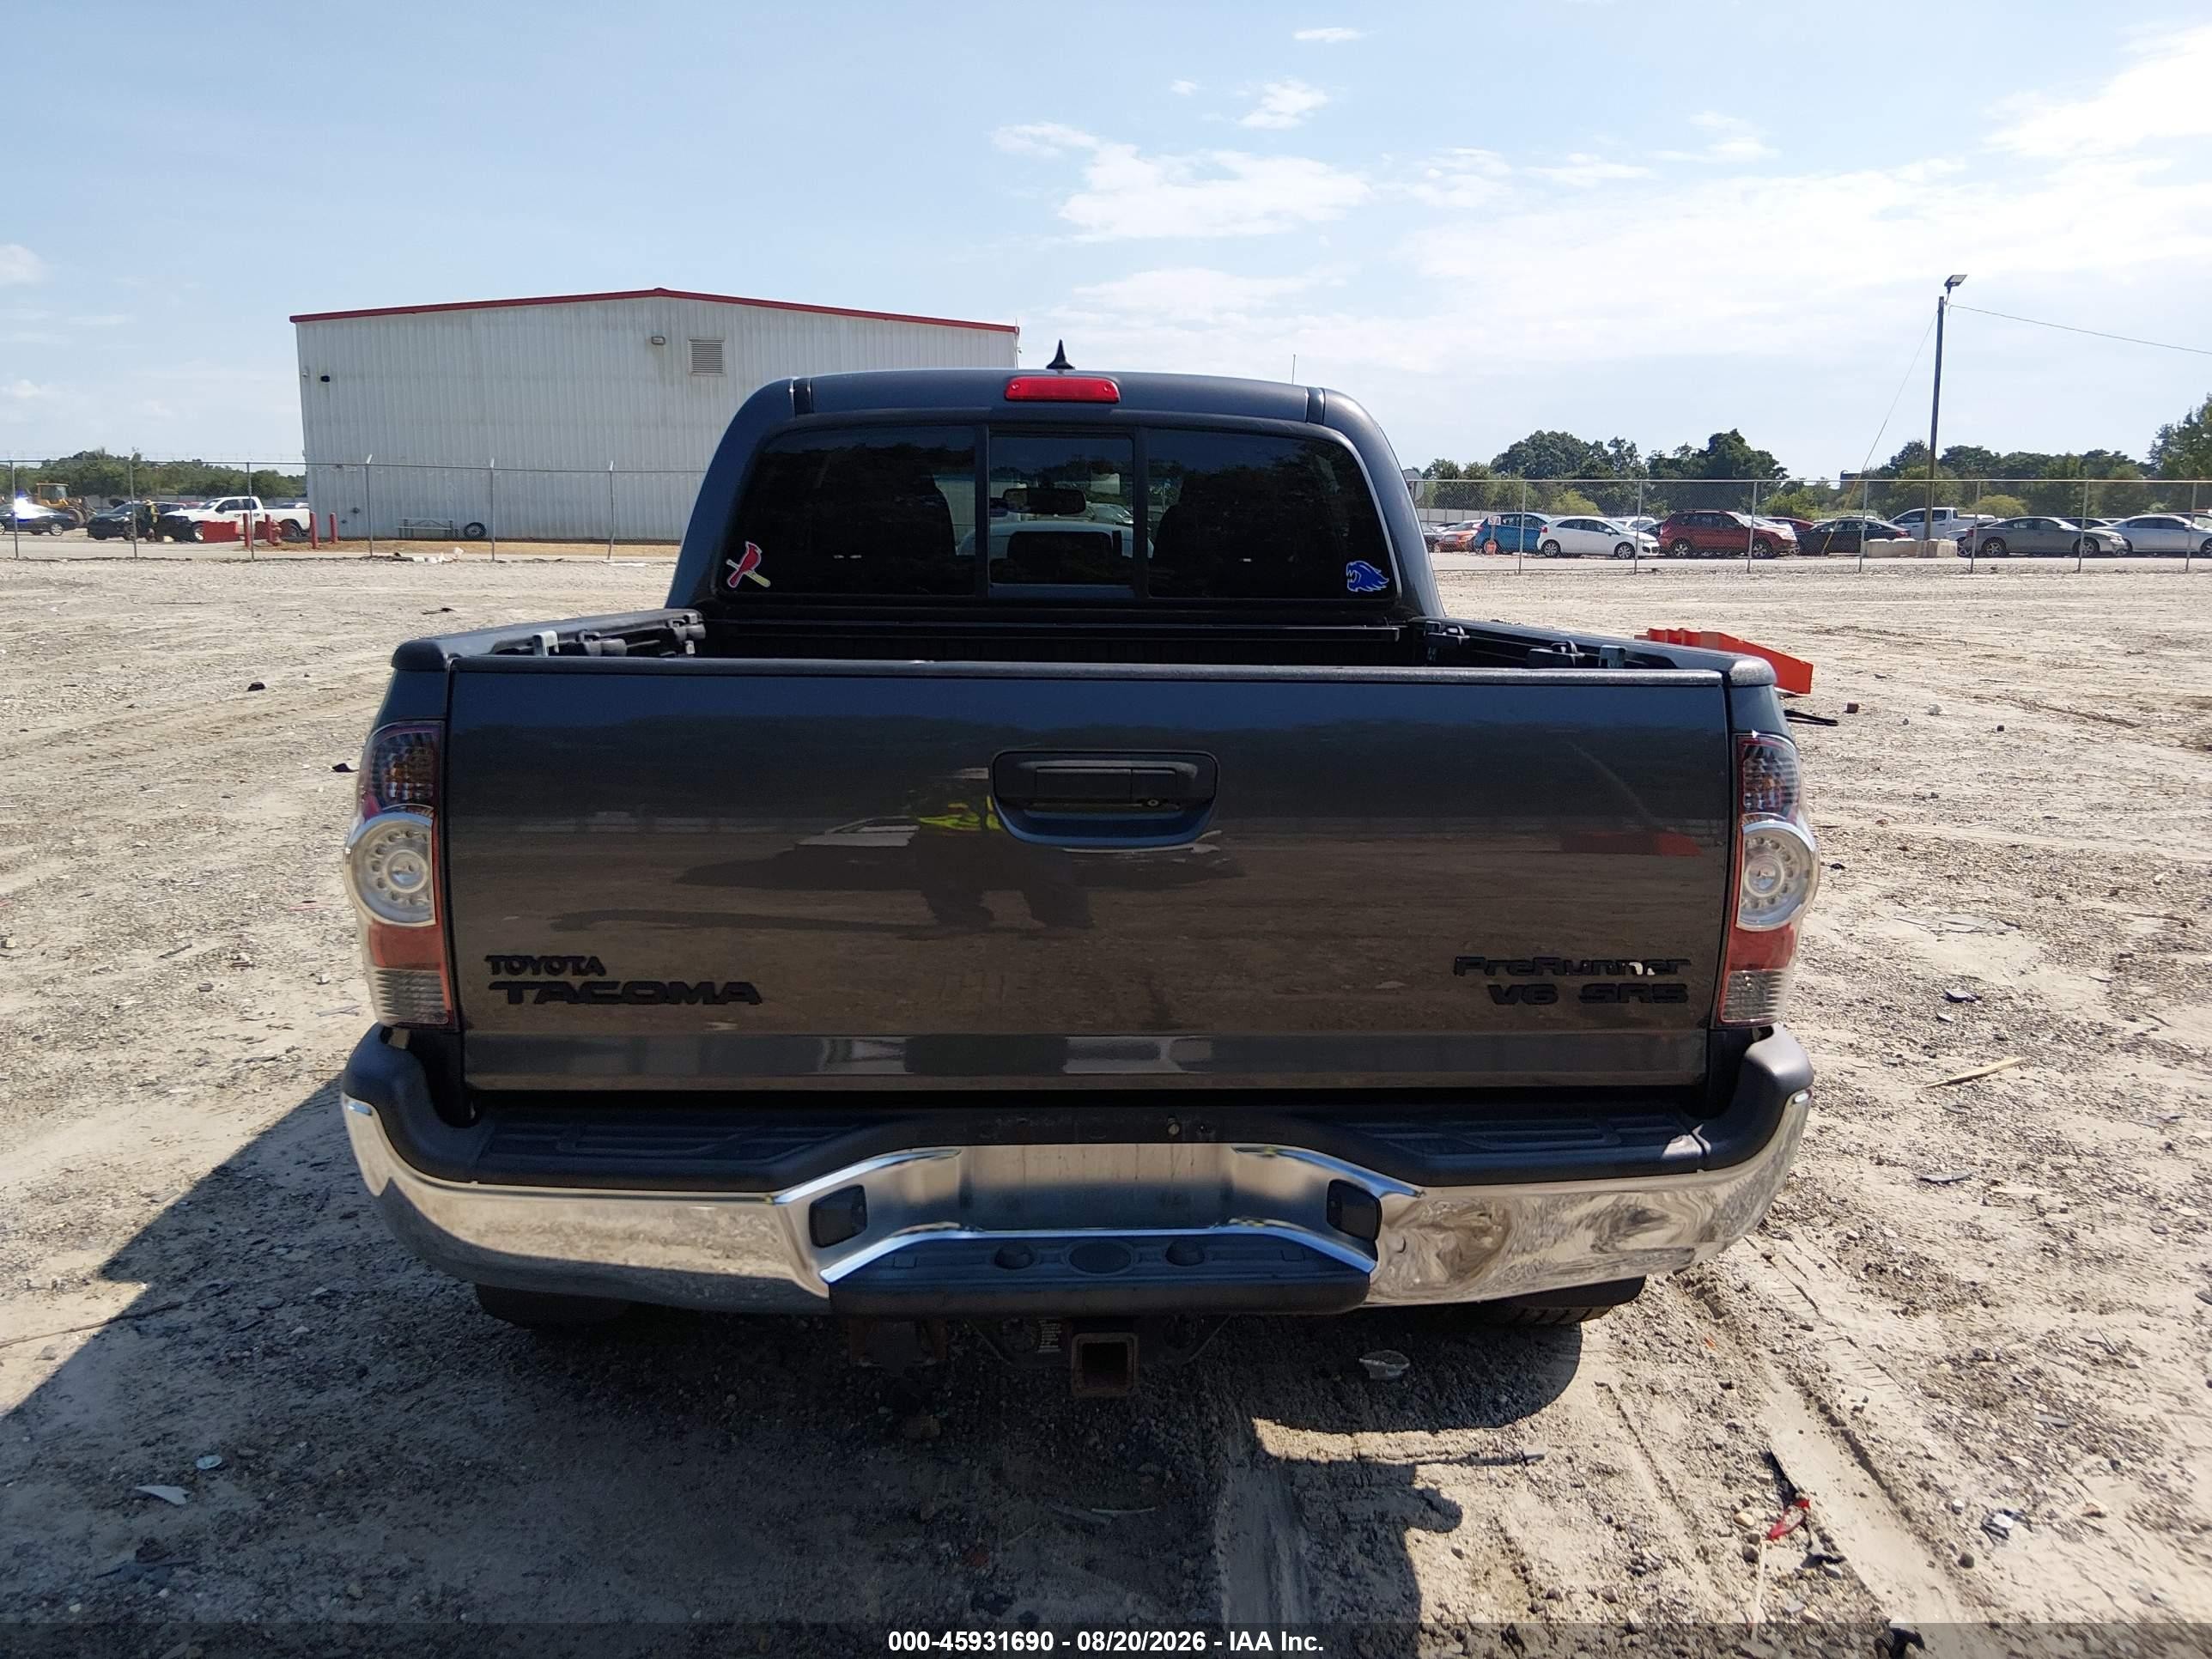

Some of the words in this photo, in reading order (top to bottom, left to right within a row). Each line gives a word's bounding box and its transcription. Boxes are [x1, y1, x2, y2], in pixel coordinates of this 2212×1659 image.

[484, 955, 606, 976] TOYOTA
[1454, 957, 1691, 976] PreRunner
[489, 981, 763, 1005] TACOMA
[1487, 983, 1559, 1005] V6
[1578, 983, 1689, 1004] SR5
